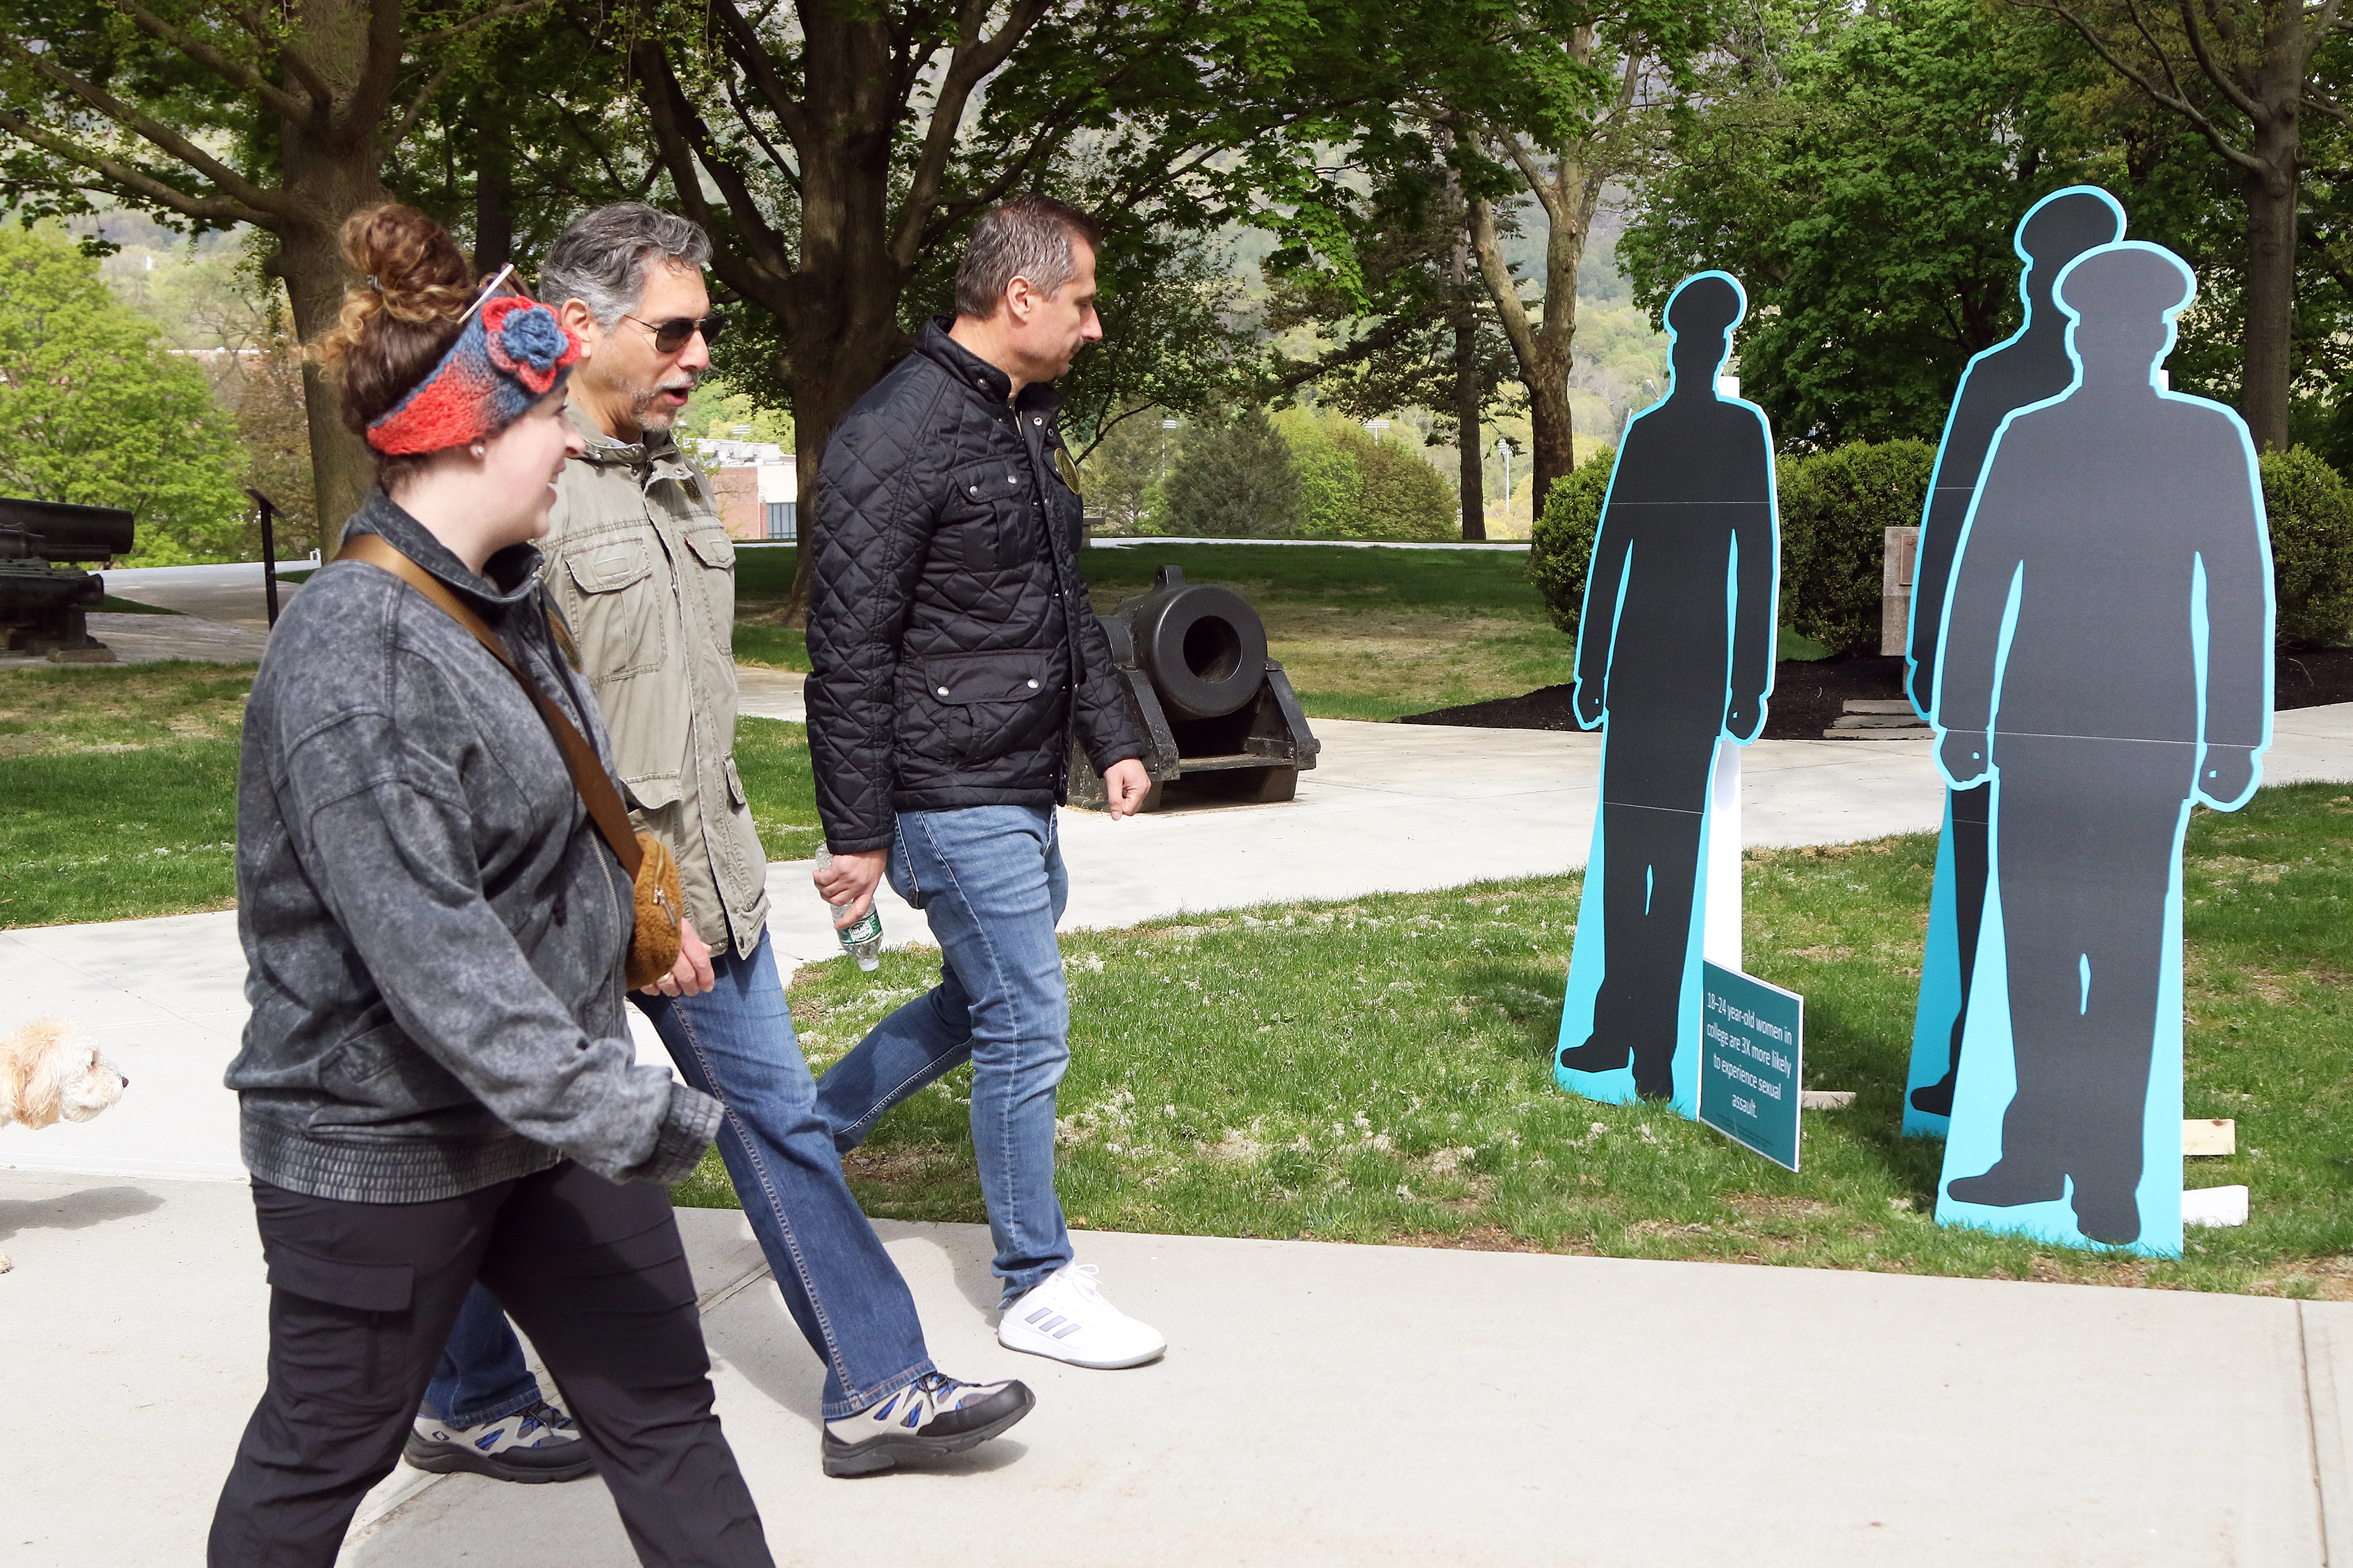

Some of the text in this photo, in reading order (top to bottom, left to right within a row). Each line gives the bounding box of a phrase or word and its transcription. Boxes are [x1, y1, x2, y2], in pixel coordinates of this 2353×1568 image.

[1727, 1004, 1755, 1029] year-old
[1755, 1018, 1783, 1041] women
[1784, 1026, 1793, 1045] in
[1707, 1022, 1792, 1079] college are 3X more likely
[1714, 1052, 1782, 1100] to experience sexual
[1732, 1094, 1758, 1119] assault.
